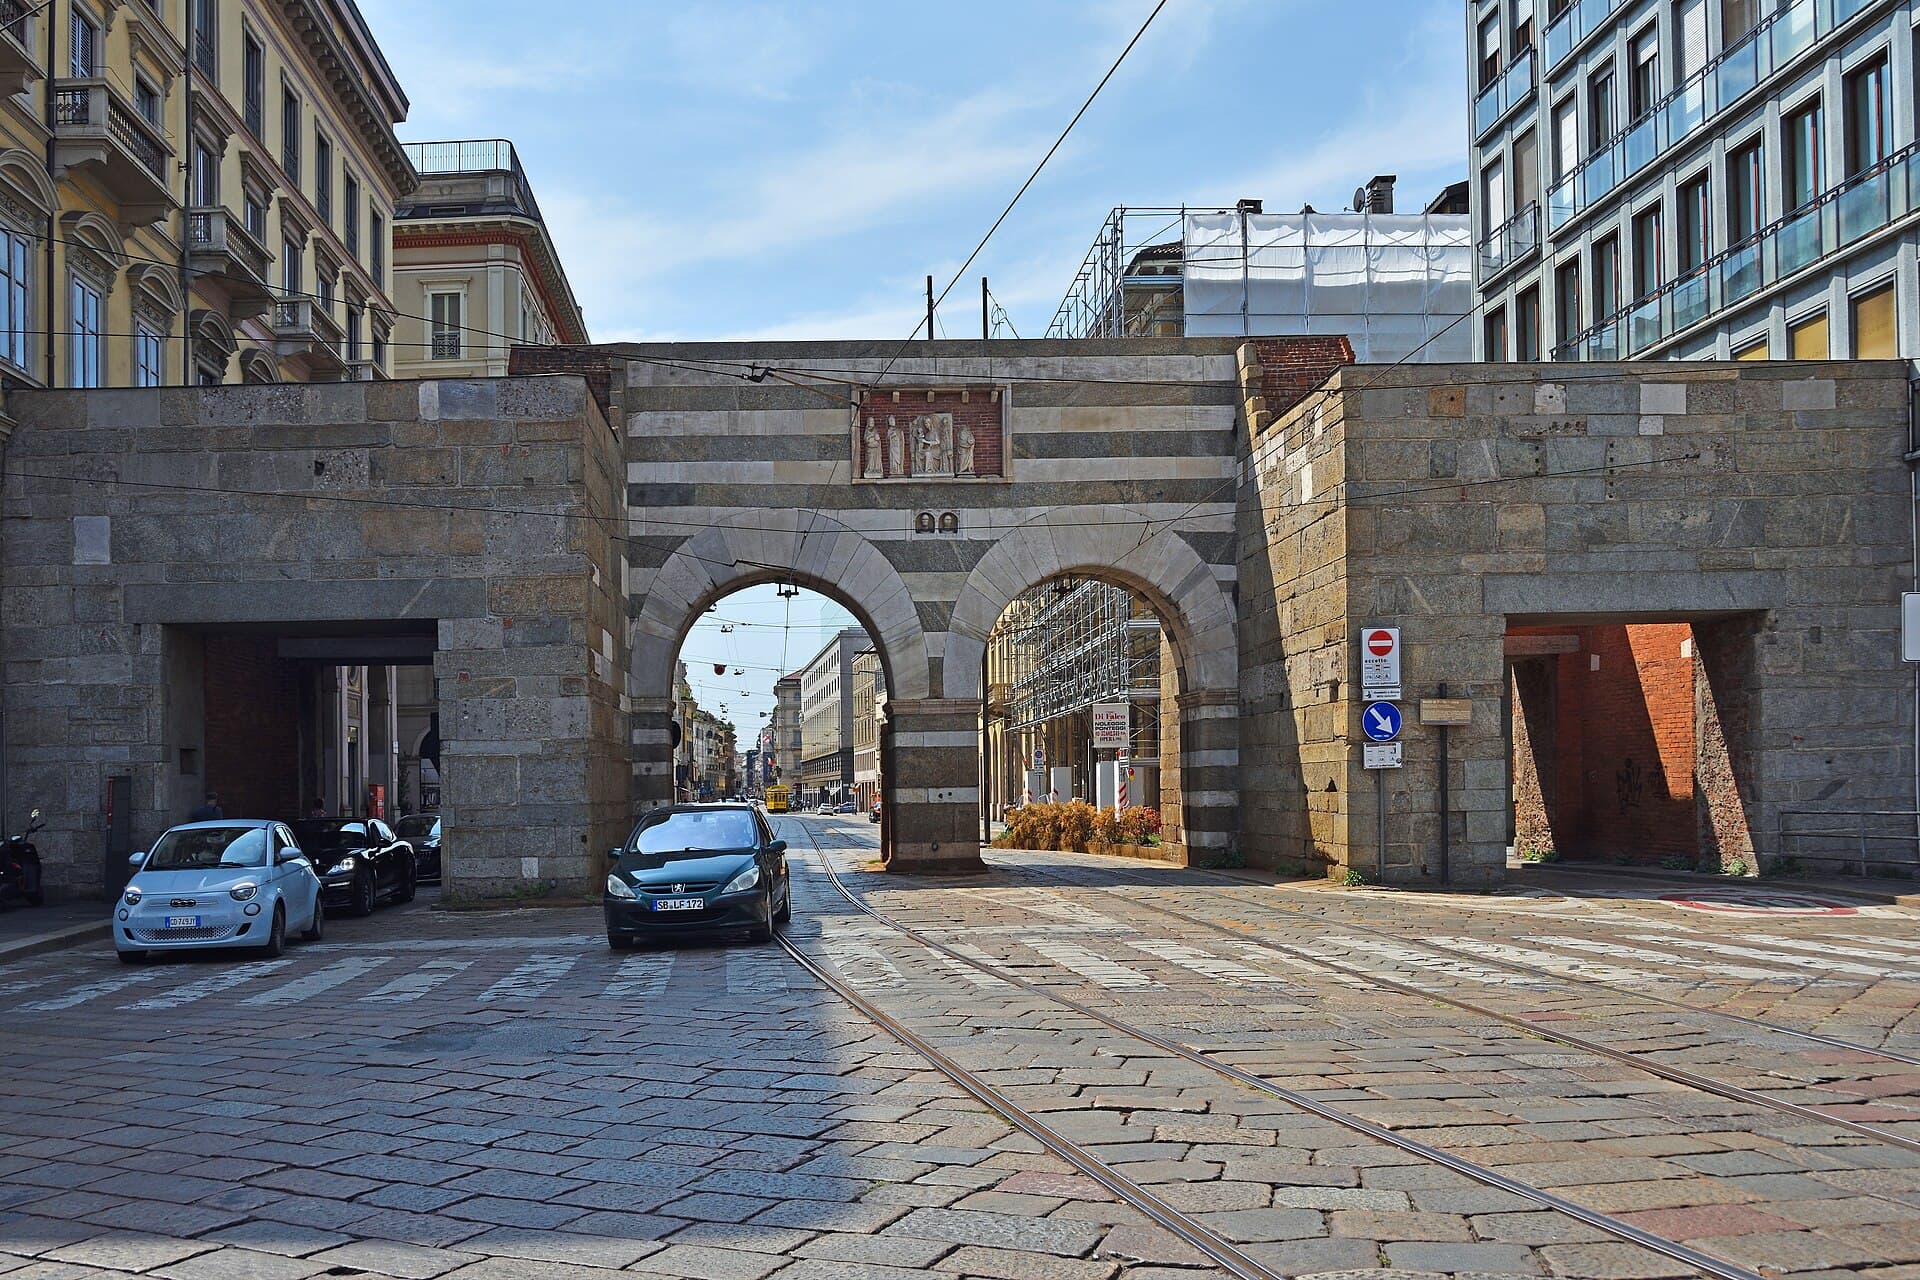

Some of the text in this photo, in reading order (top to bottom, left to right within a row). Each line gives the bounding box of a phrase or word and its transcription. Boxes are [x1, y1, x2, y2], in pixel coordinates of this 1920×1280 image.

[658, 899, 703, 910] SB LF 172
